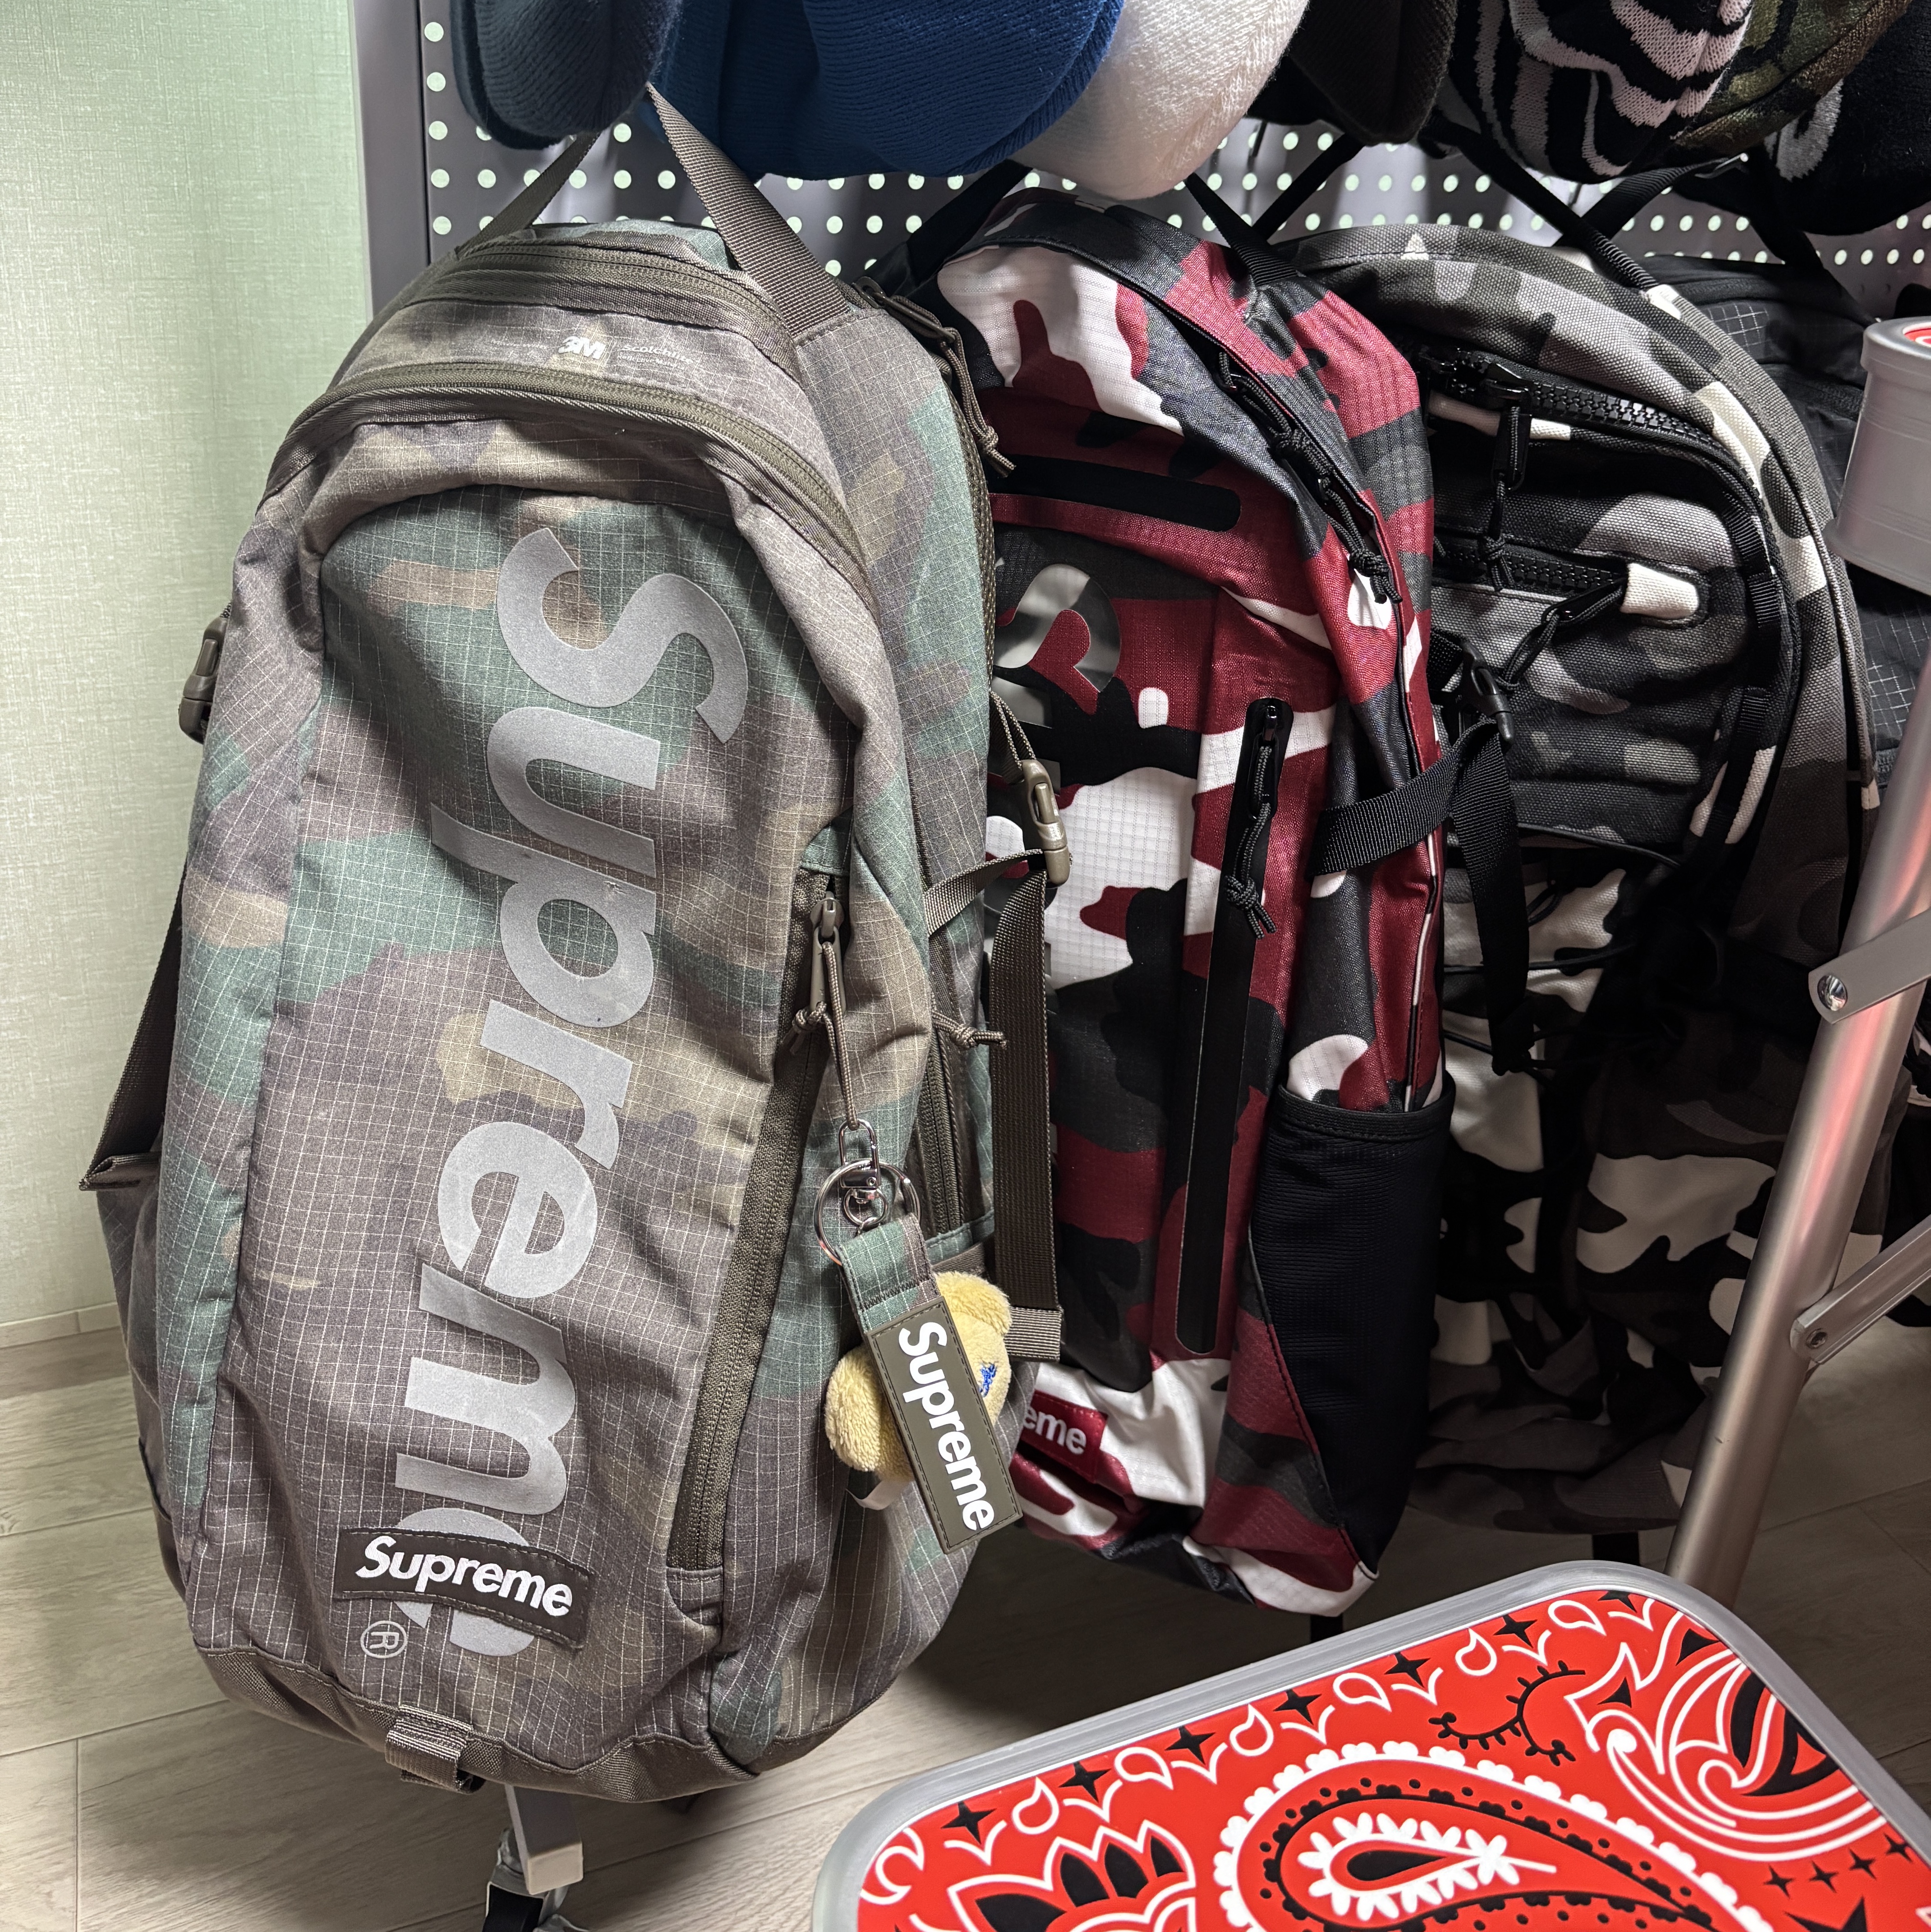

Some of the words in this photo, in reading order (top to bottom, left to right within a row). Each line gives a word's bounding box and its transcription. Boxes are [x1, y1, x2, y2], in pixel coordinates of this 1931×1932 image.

[558, 335, 606, 359] 3M
[898, 1322, 995, 1531] Supreme
[355, 1535, 573, 1616] Supreme
